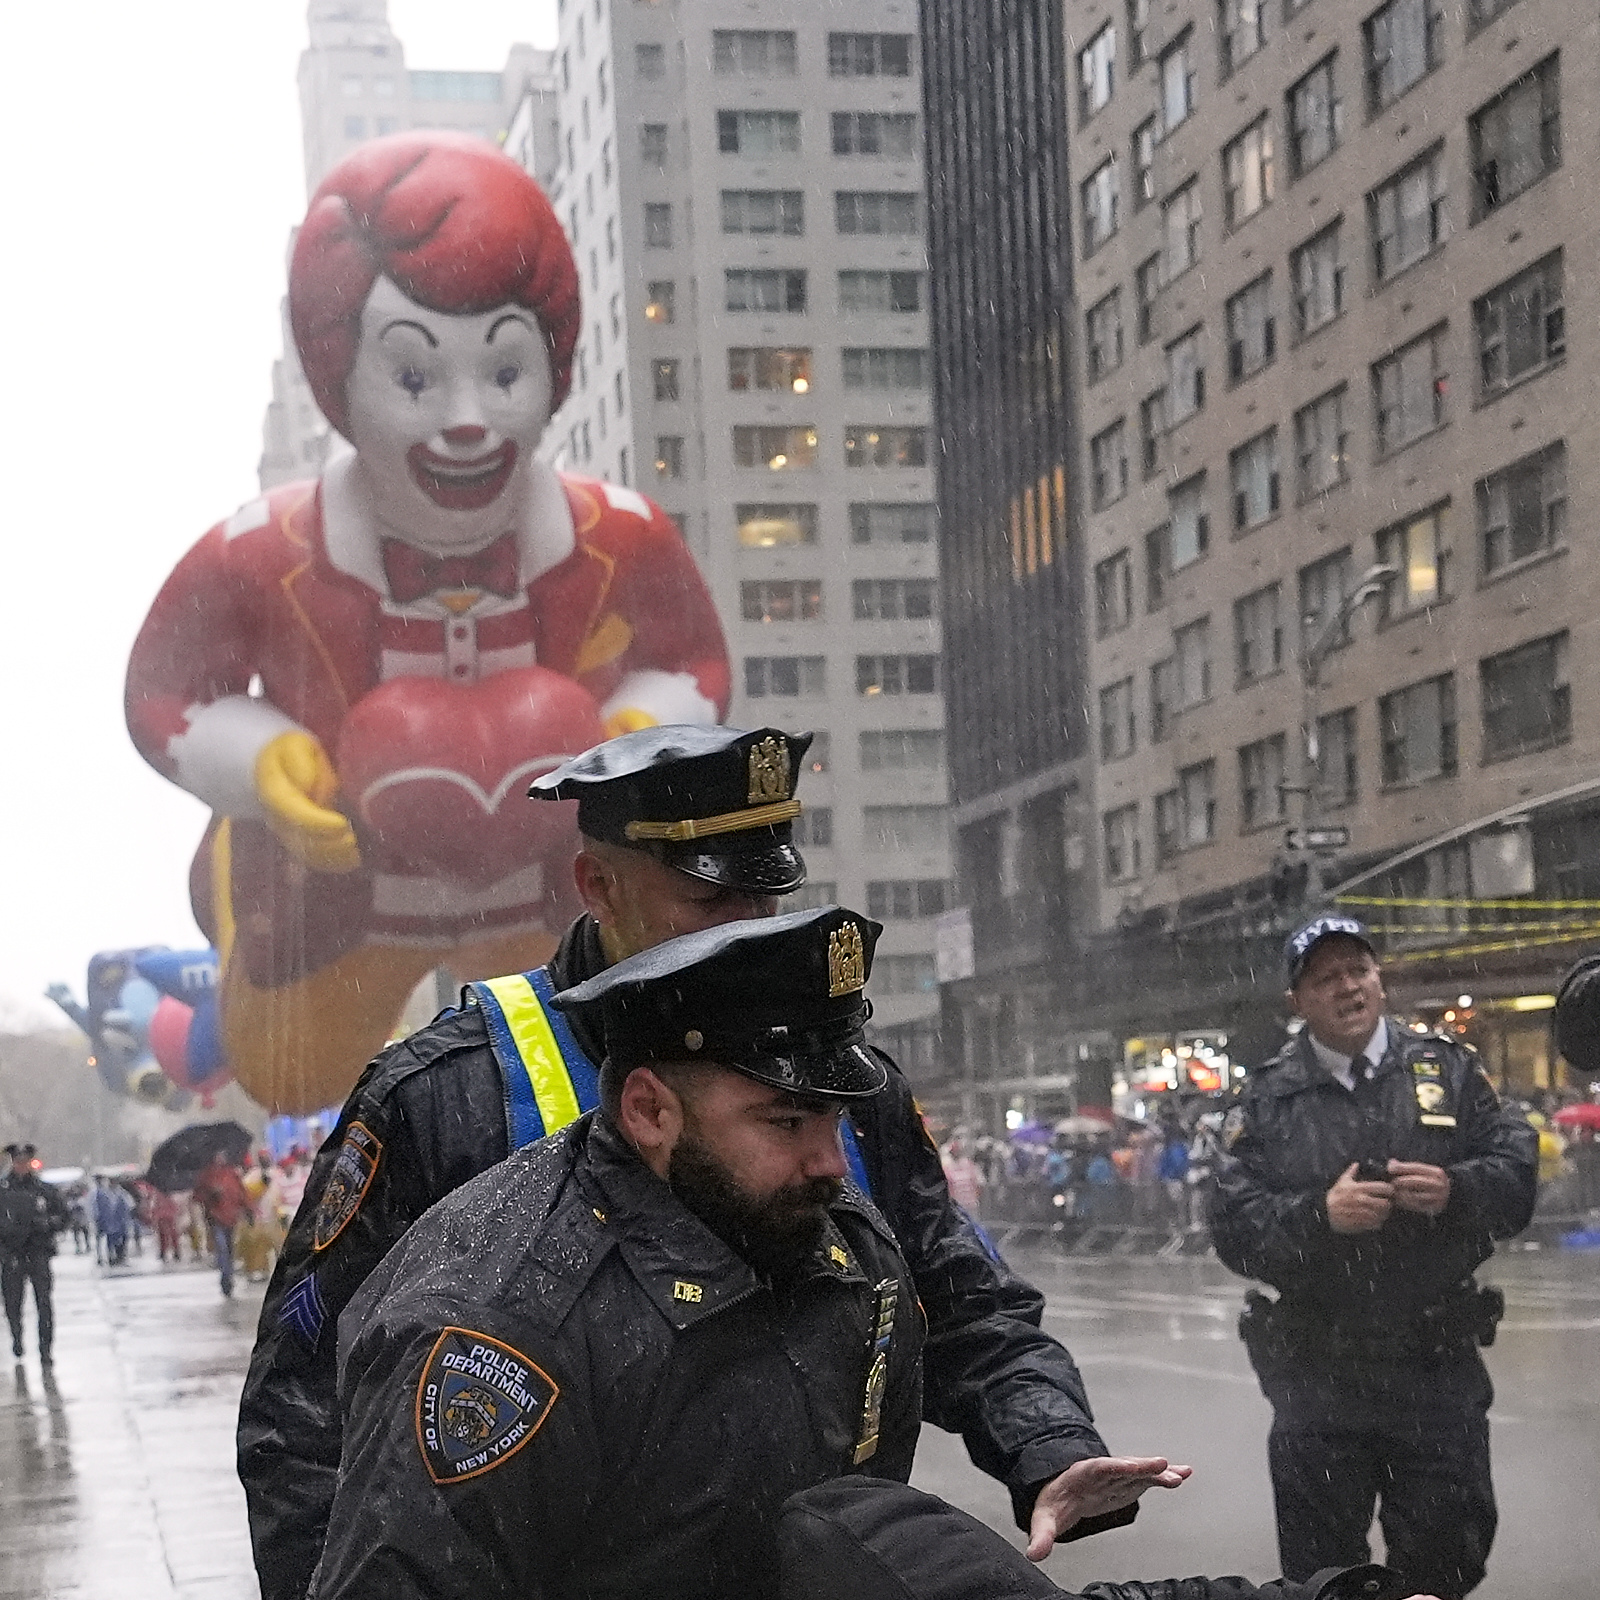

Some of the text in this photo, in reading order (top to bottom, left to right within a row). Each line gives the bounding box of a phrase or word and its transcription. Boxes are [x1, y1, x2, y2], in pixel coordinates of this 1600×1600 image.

[1292, 918, 1360, 955] NYPD
[440, 1352, 539, 1413] DEPARTMENT
[469, 1344, 529, 1384] POLICE
[424, 1383, 439, 1451] CITY OF
[455, 1420, 531, 1473] NEW YORK
